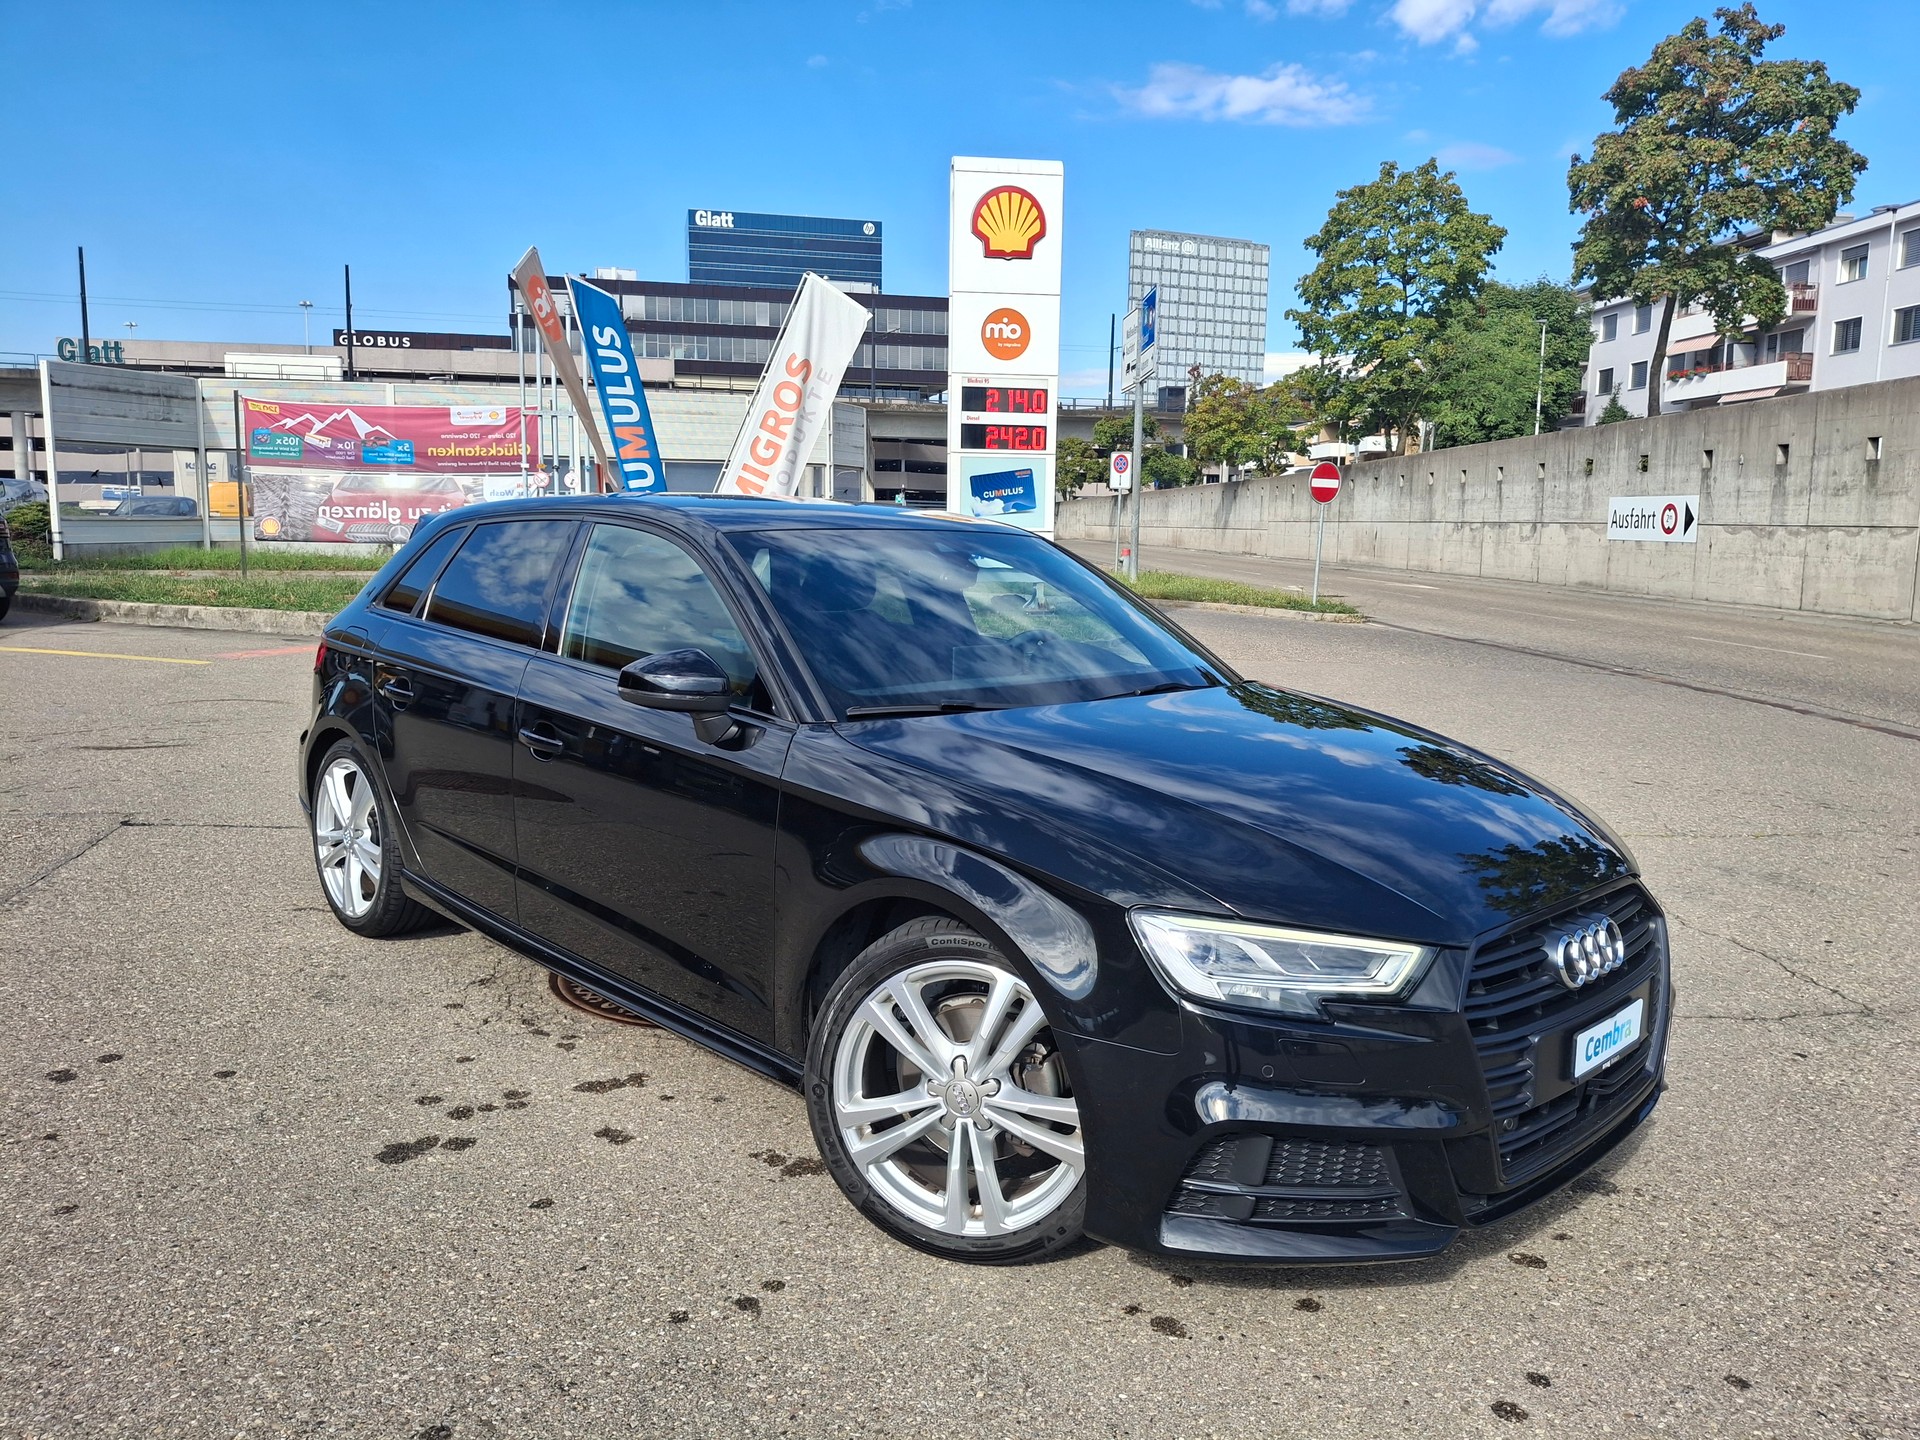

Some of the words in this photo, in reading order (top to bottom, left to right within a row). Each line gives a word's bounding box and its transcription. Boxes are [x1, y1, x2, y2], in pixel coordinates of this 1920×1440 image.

[694, 209, 734, 228] Glatt
[864, 223, 874, 234] hp
[1144, 238, 1180, 251] Allianz
[985, 317, 1022, 339] mio
[57, 337, 125, 364] Glatt
[339, 334, 411, 348] GLOBUS
[592, 324, 655, 493] UMULUS
[771, 367, 833, 494] ODUKTE
[986, 426, 1045, 450] 242.0
[983, 486, 1024, 499] CUMULUS
[1610, 507, 1657, 530] Ausfahrt
[931, 938, 1000, 951] ContiSportC
[1584, 1019, 1632, 1062] Cembra
